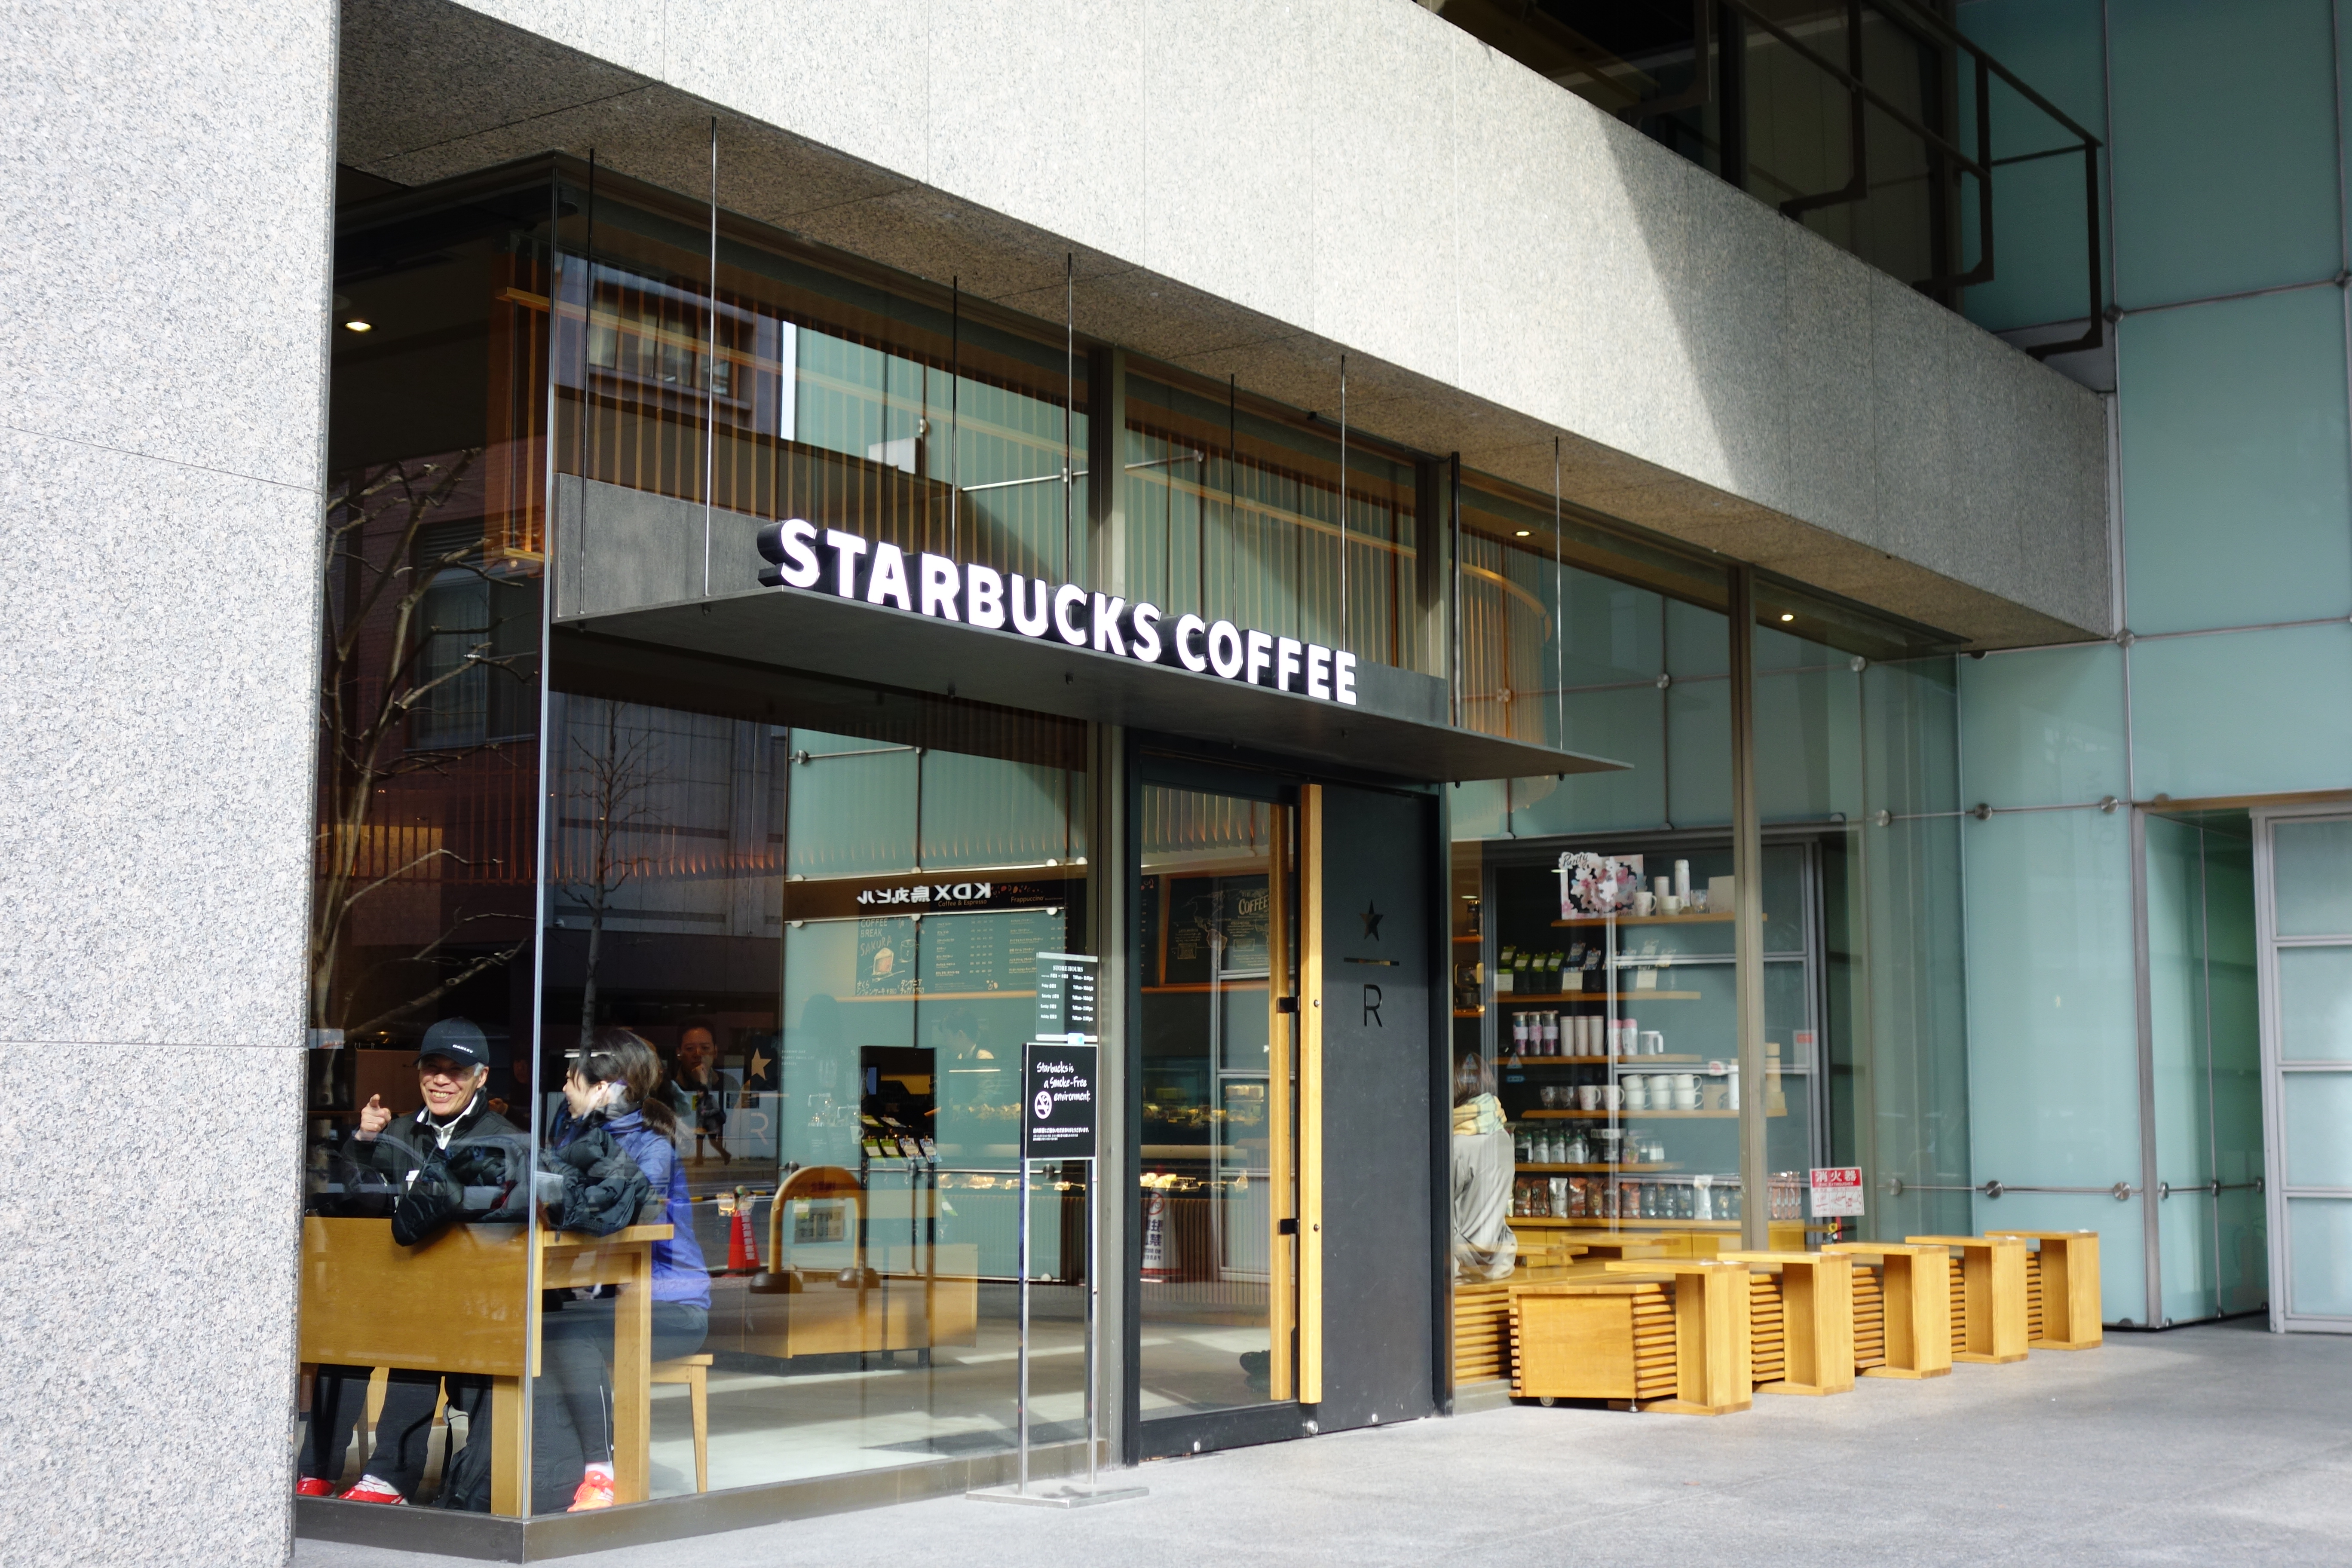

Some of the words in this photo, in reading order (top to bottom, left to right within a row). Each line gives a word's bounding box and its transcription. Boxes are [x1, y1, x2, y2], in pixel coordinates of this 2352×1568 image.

[779, 518, 1162, 663] STARBUCKS
[1176, 613, 1357, 705] COFFEE
[1563, 854, 1589, 867] Purity
[861, 918, 888, 928] COFFEE
[861, 929, 882, 938] BREAK
[861, 935, 892, 956] SAKURA
[1364, 983, 1383, 1028] R
[1037, 1061, 1068, 1073] Starbucks
[1069, 1063, 1074, 1073] is
[1044, 1080, 1049, 1089] a
[1050, 1076, 1087, 1089] Smoke-Free
[1816, 1170, 1857, 1182] 消火器
